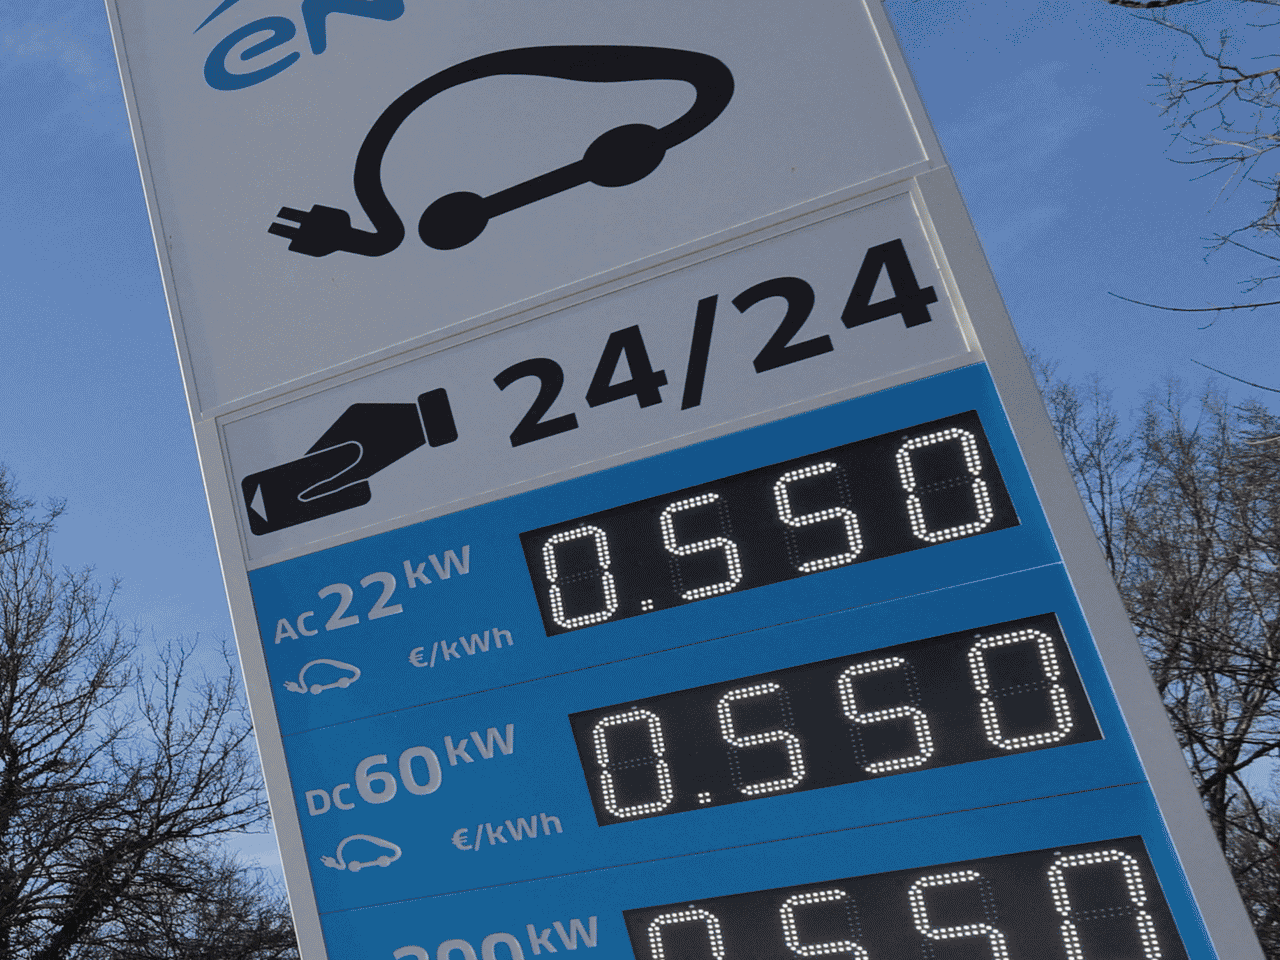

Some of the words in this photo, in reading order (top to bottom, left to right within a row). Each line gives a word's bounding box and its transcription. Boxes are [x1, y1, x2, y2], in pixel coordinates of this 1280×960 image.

[492, 237, 939, 448] 24/24
[542, 427, 993, 630] 0.550
[408, 627, 514, 668] €/kWh
[592, 628, 1074, 820] 0.550
[451, 813, 563, 851] €/kWh
